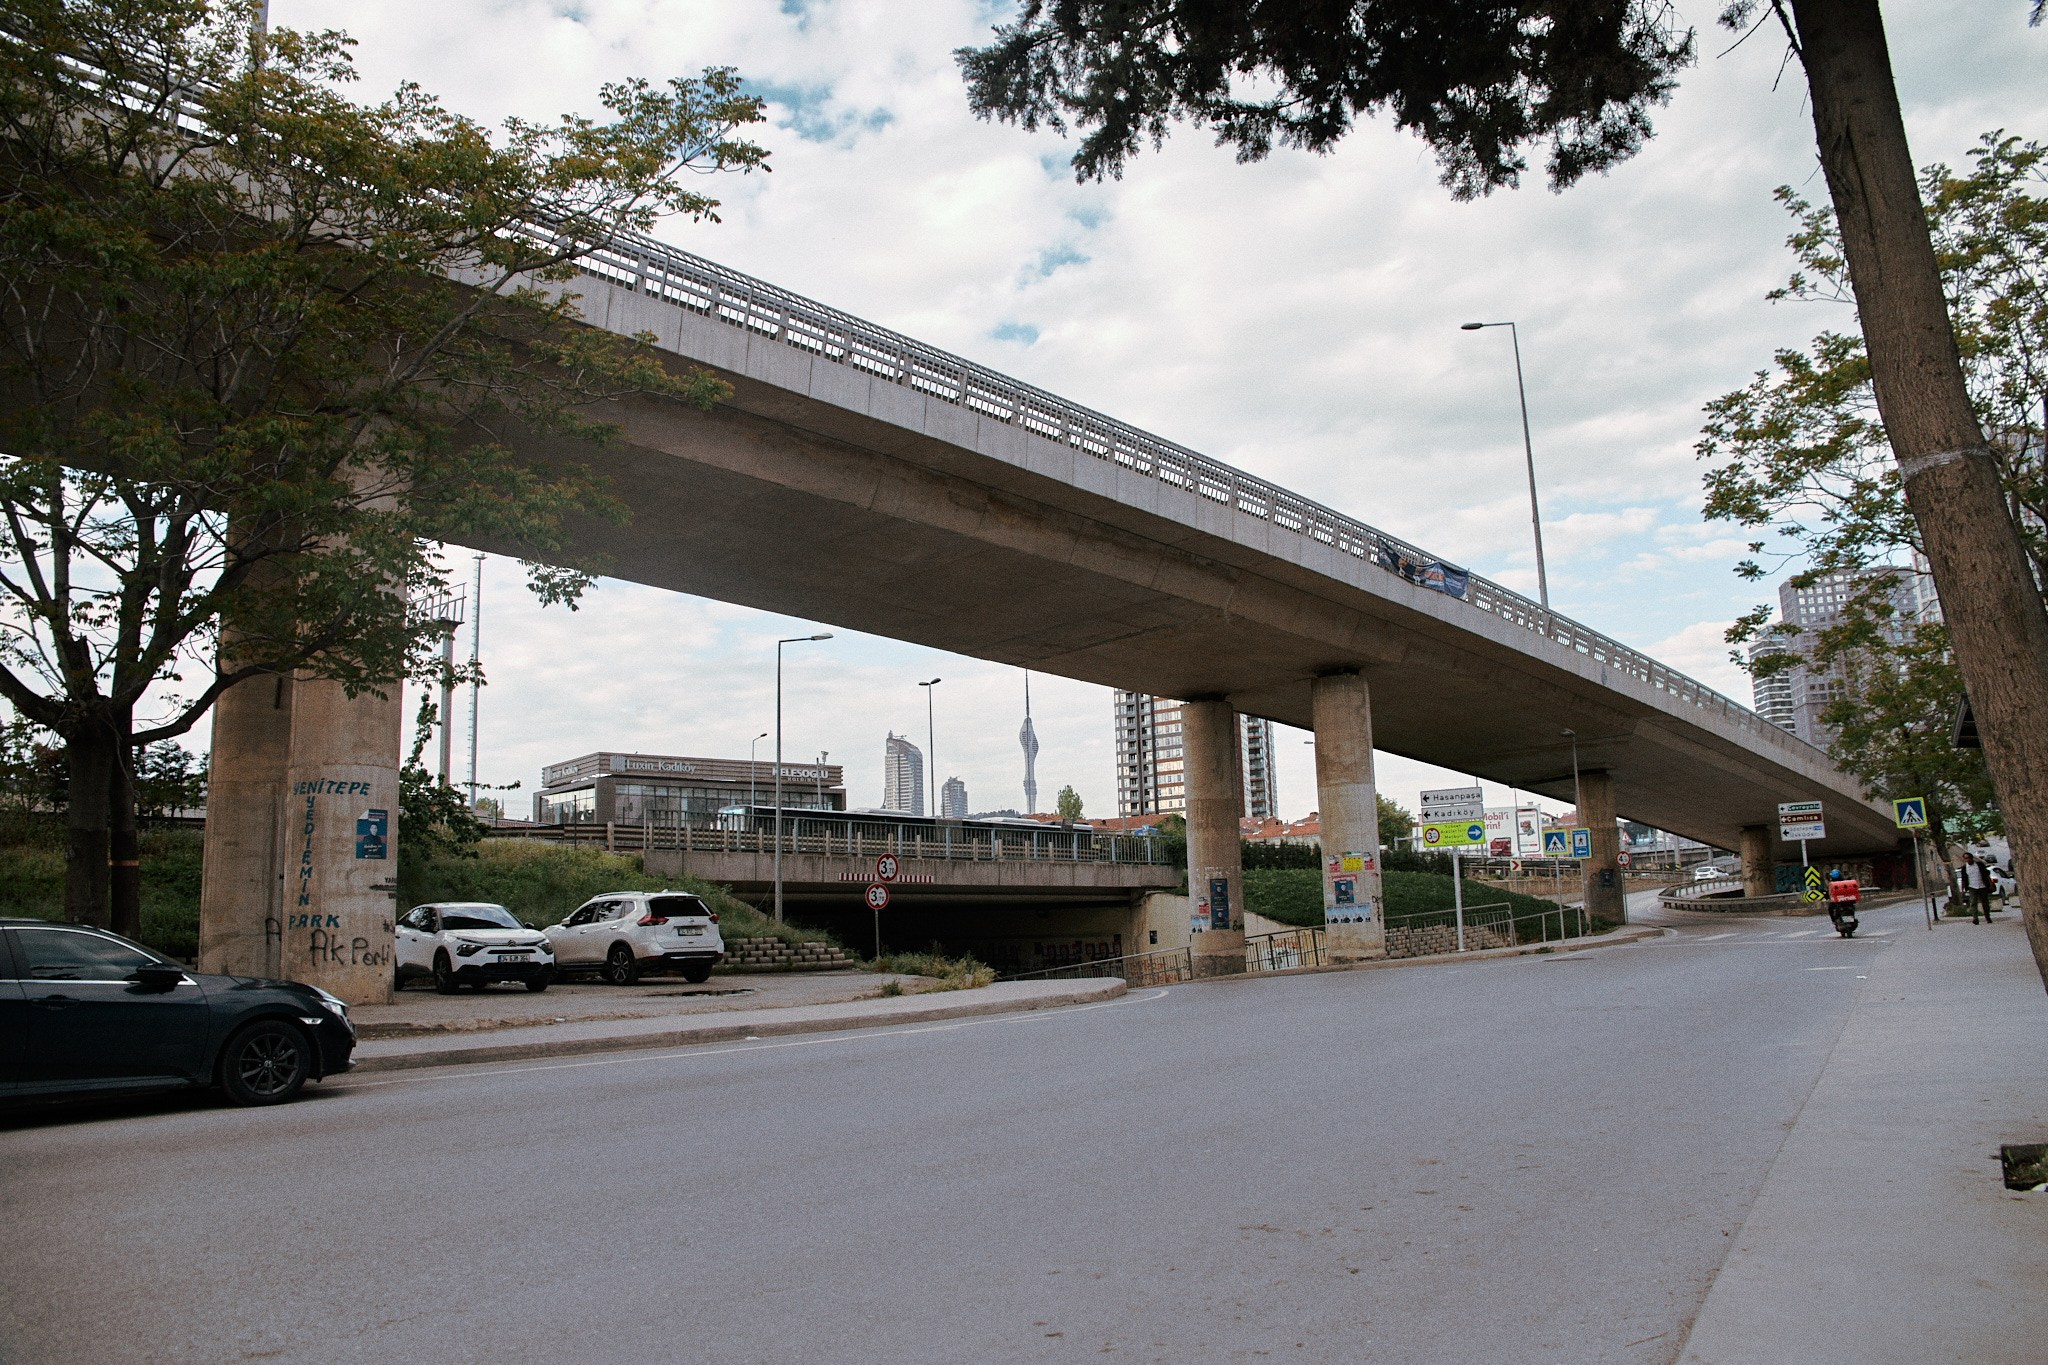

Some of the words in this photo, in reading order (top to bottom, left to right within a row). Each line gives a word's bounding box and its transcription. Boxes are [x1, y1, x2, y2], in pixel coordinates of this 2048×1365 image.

[626, 759, 654, 771] Luxin
[658, 759, 697, 774] Kadıköy
[293, 778, 371, 796] YENİTEPE
[1433, 793, 1481, 801] Hasanpaşa
[1434, 809, 1475, 817] Kadıköy
[880, 861, 887, 875] 3
[871, 890, 878, 902] 3
[288, 914, 340, 930] PARK
